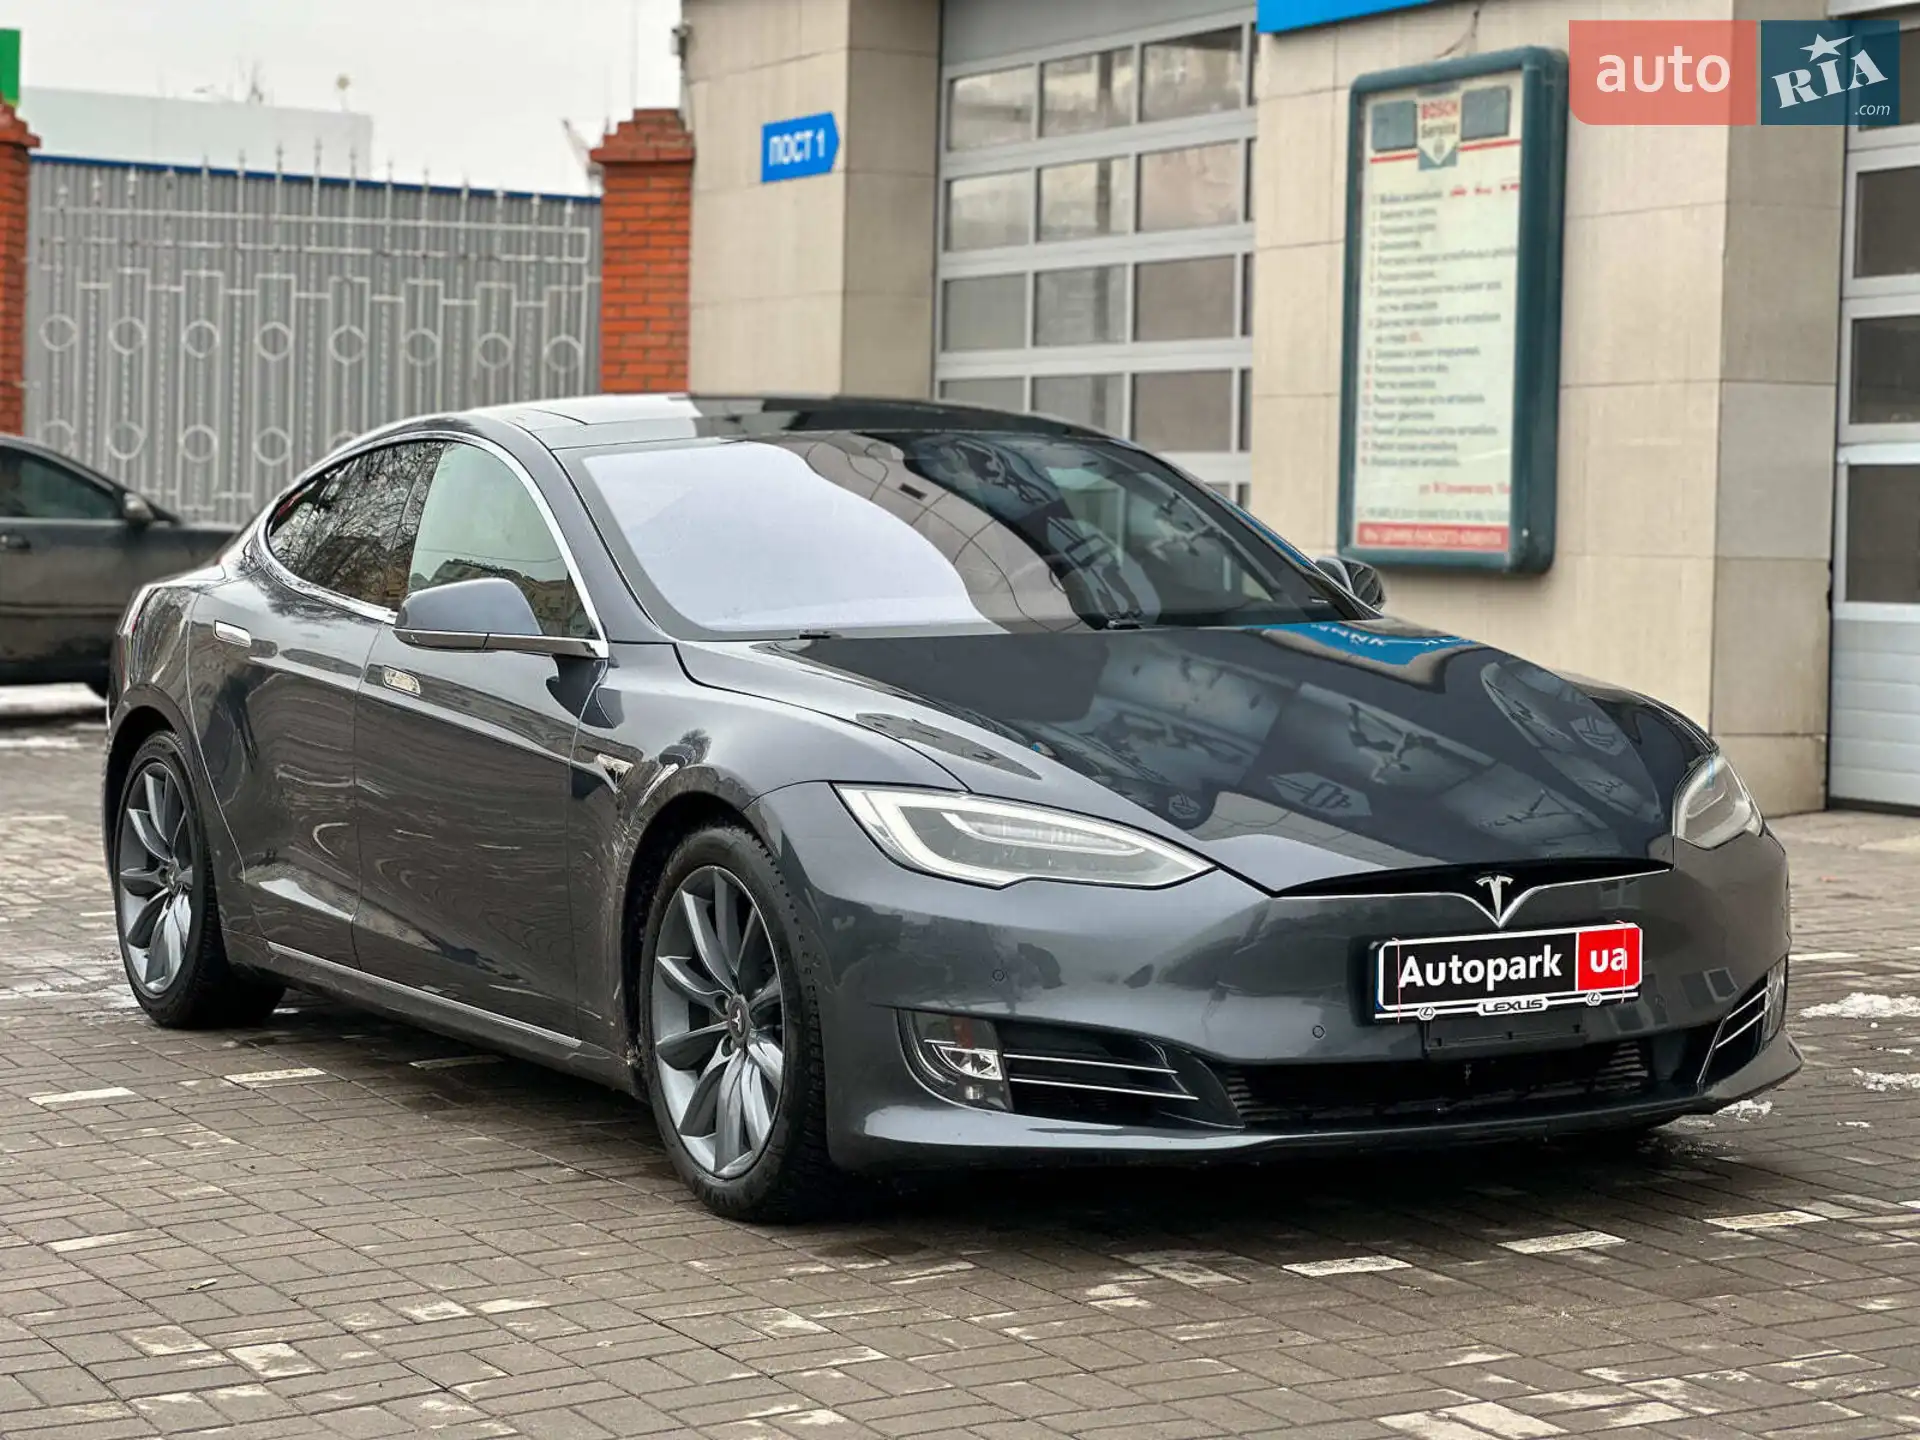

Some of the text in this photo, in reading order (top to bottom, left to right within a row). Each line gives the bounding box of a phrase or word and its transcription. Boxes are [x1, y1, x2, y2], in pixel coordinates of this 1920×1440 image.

[1421, 100, 1458, 120] BOSCH
[769, 127, 825, 166] ПОСТ 1
[1398, 944, 1628, 992] Autopark ua
[1482, 999, 1543, 1014] LEXUS
